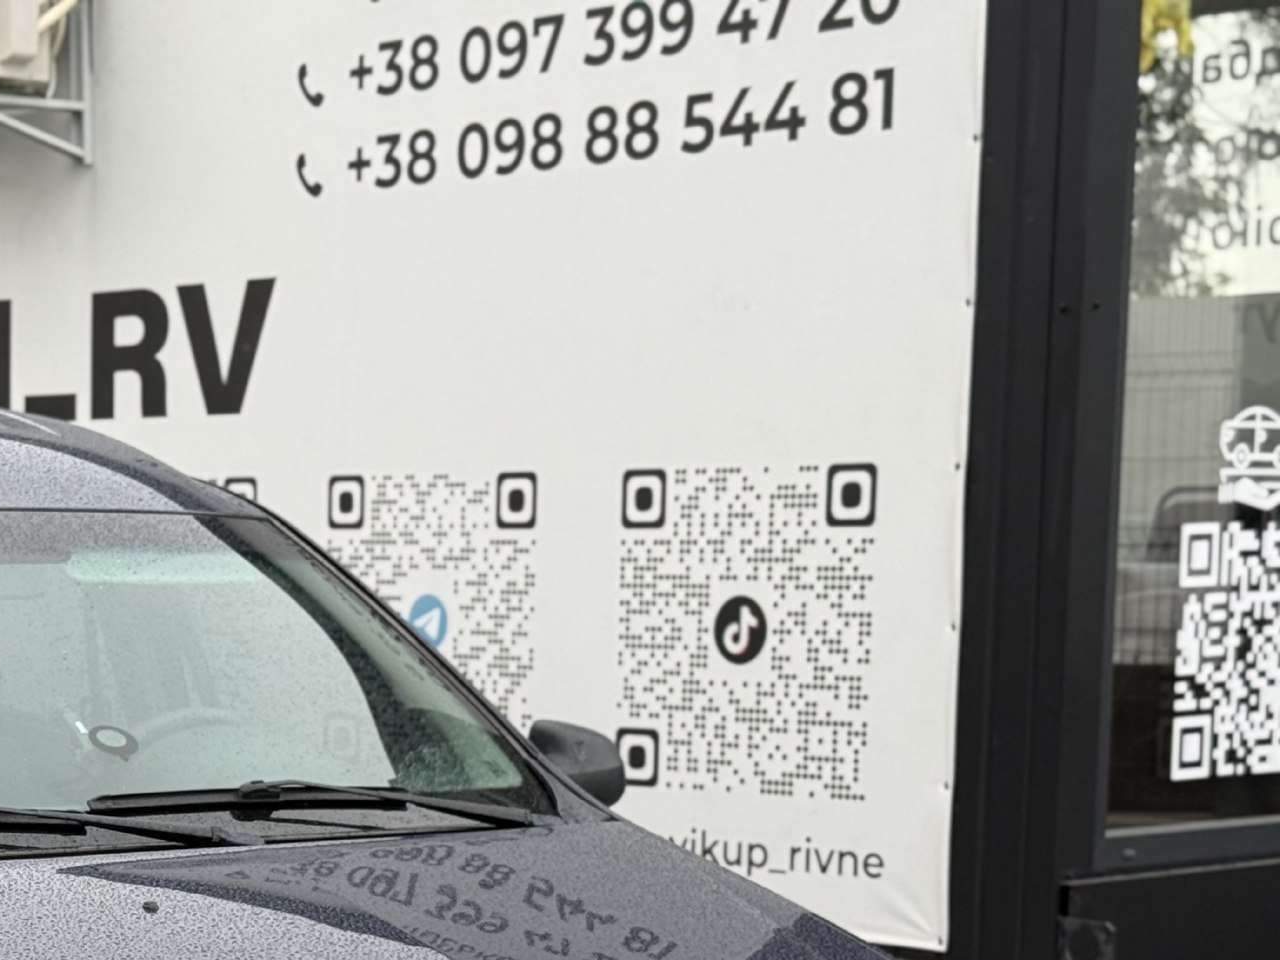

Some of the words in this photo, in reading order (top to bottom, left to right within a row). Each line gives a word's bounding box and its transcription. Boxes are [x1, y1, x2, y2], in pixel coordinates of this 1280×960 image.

[349, 34, 439, 96] +38
[459, 13, 565, 84] 097
[583, 0, 694, 67] 399
[716, 0, 791, 44] 47
[348, 129, 437, 189] +38
[457, 112, 563, 179] 098
[585, 100, 660, 165] 88
[681, 80, 807, 154] 544
[829, 67, 896, 136] 81
